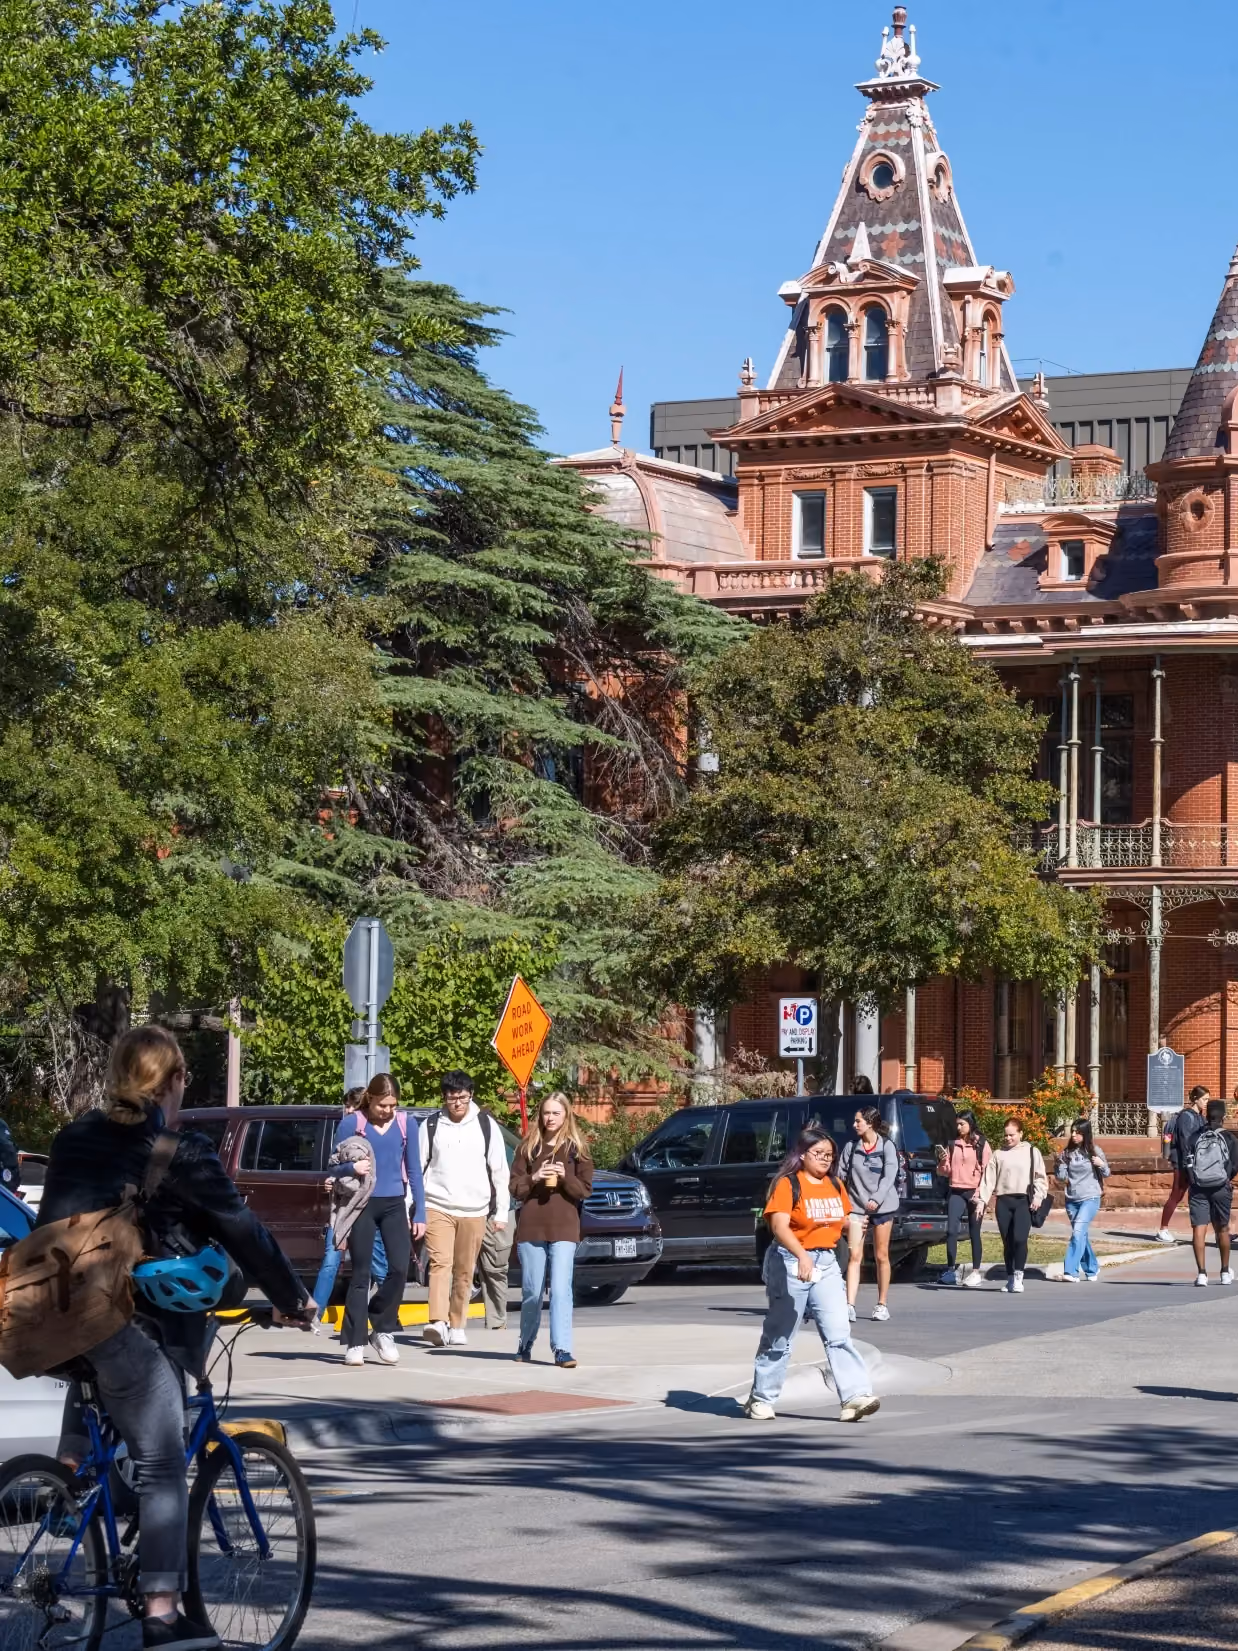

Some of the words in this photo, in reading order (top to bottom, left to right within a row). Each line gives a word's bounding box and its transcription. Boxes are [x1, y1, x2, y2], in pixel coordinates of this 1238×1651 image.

[512, 1002, 531, 1020] ROAD
[800, 1008, 810, 1025] P
[512, 1021, 533, 1040] WORK
[789, 1028, 797, 1036] AND
[799, 1027, 816, 1036] DISPLAY
[790, 1036, 808, 1045] PARKING
[512, 1040, 535, 1060] AHEAD
